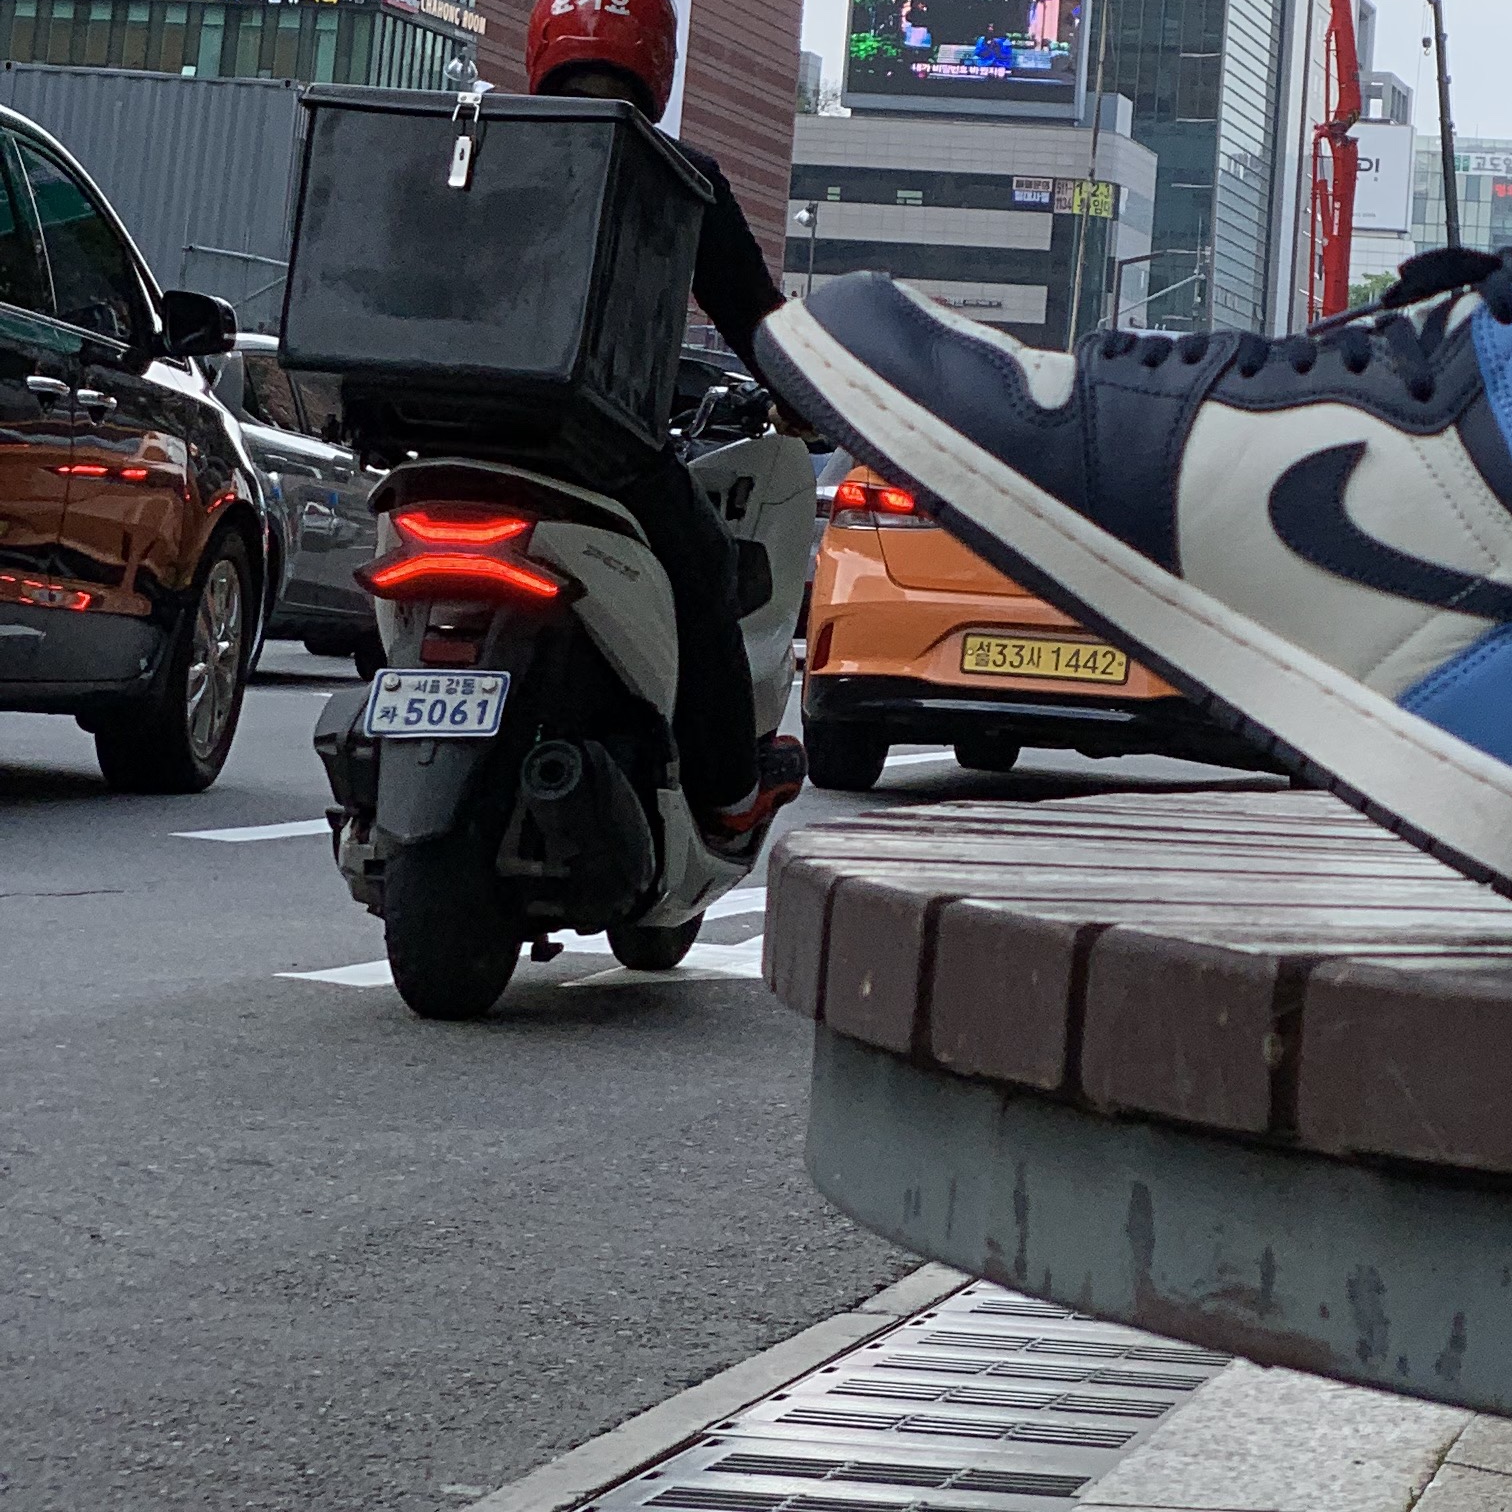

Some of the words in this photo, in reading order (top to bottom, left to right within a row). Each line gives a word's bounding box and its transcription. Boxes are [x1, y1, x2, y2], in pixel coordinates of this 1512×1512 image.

[1051, 646, 1117, 676] 1442
[414, 678, 441, 694] 서울
[404, 697, 490, 727] 5061
